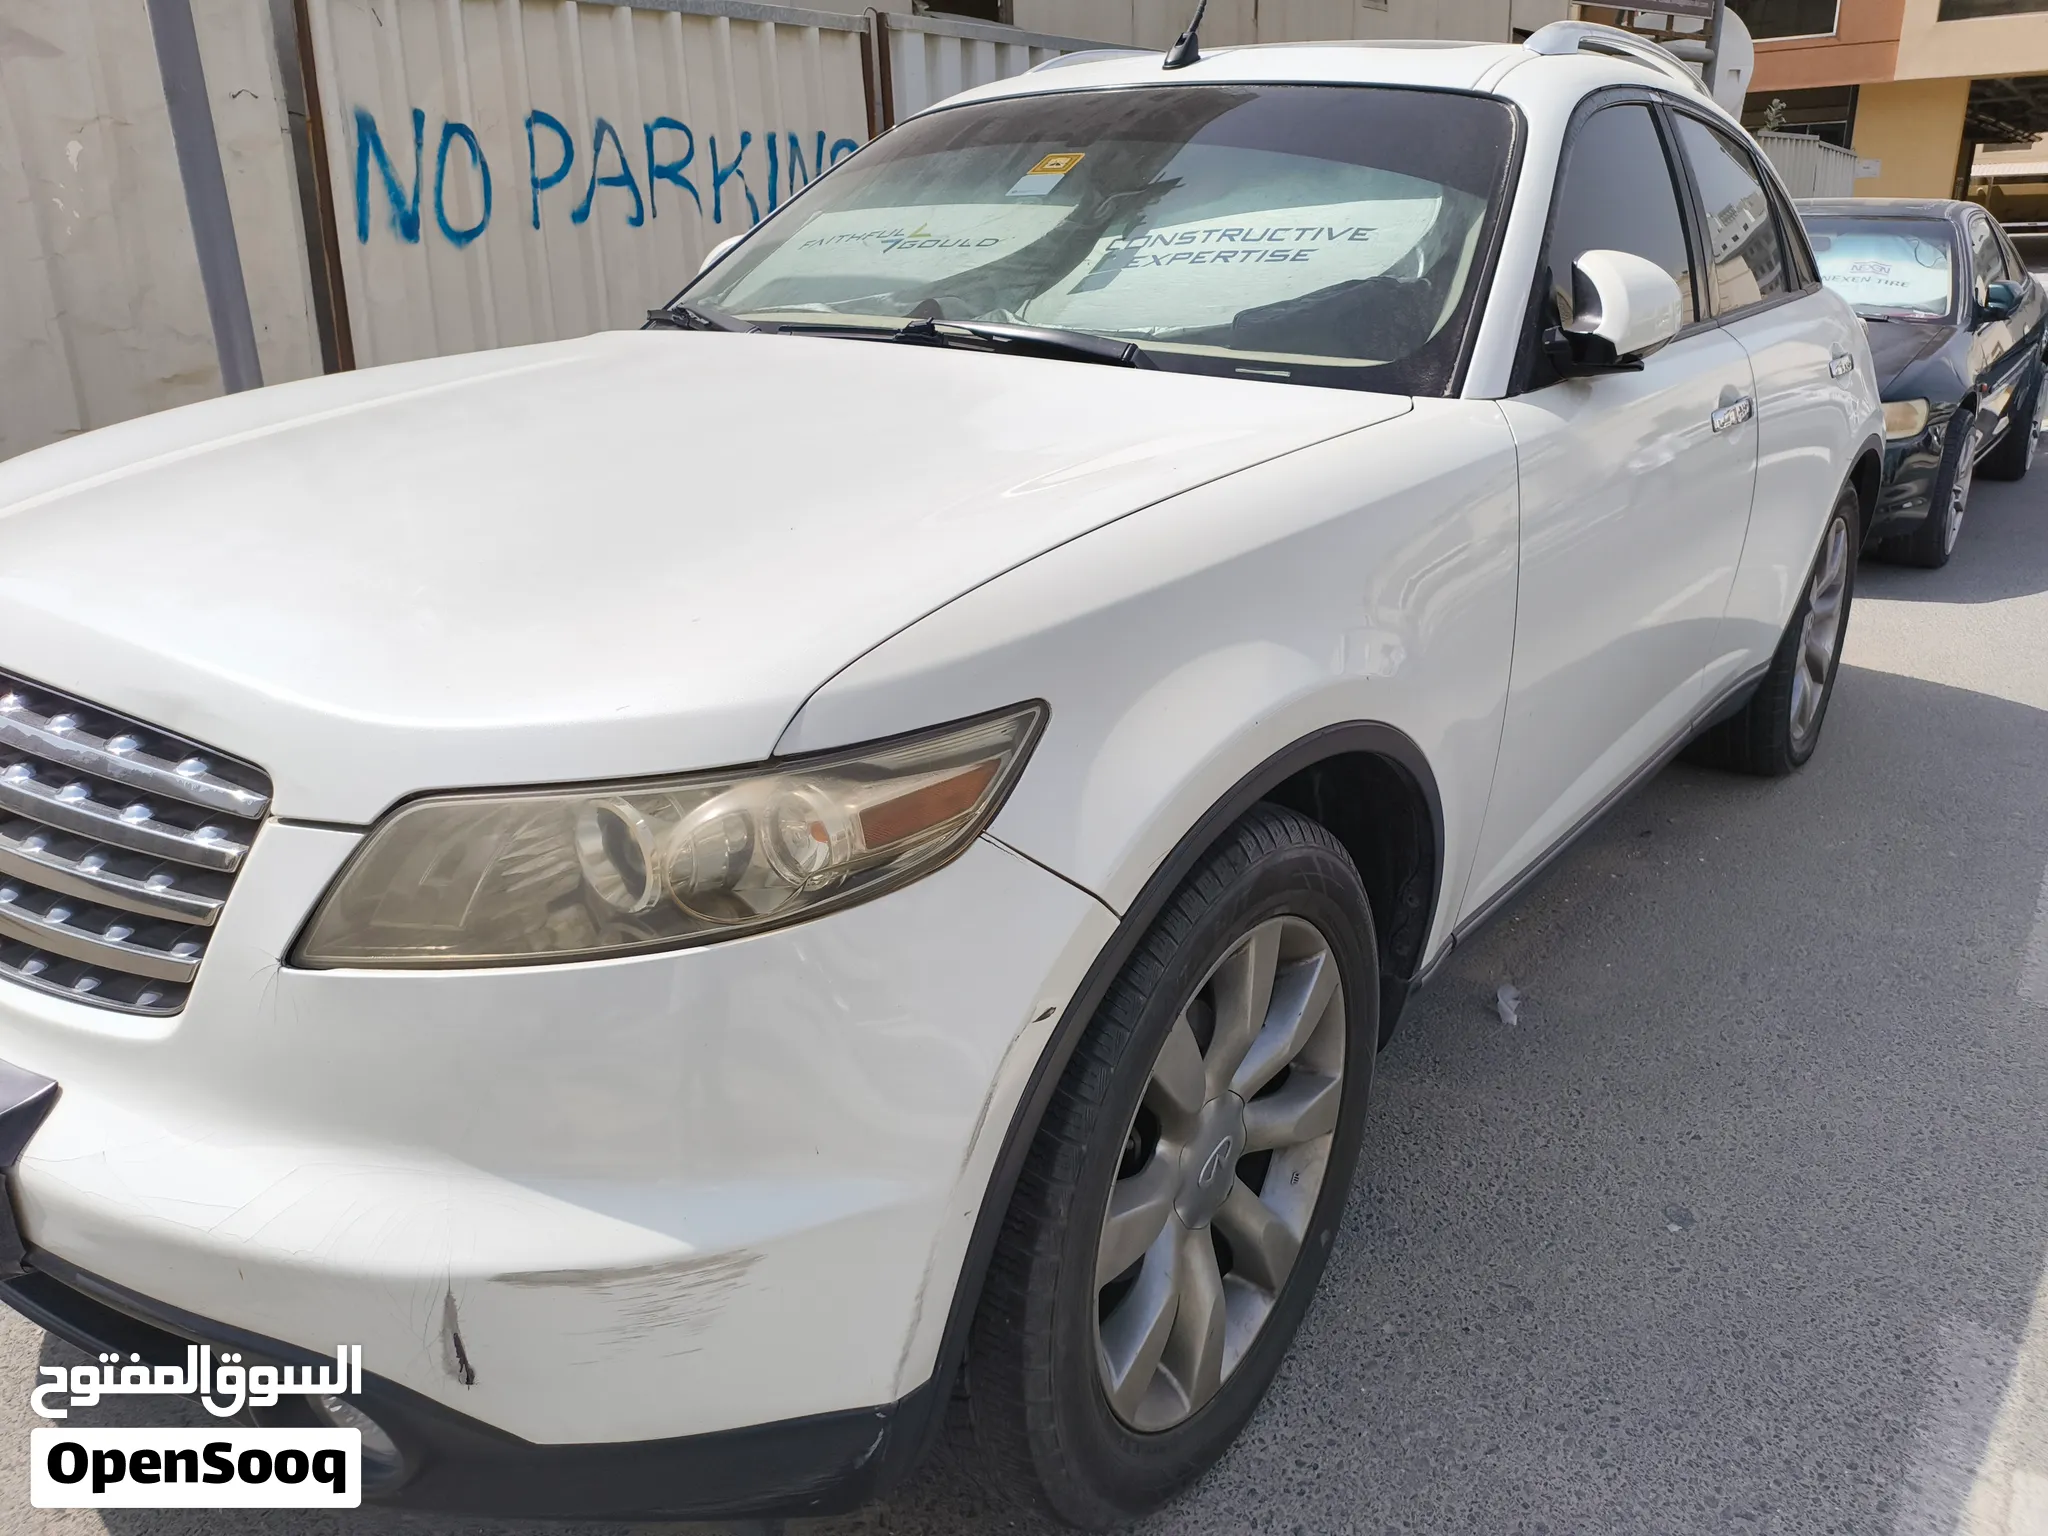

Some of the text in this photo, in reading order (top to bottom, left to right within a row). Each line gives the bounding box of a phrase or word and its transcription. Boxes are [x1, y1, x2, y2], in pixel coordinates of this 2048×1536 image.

[355, 106, 493, 248] NO
[797, 228, 905, 250] FAITHFUL
[897, 237, 1001, 250] GOULD
[1105, 227, 1378, 251] CONSTRUCTIVE
[1124, 248, 1319, 269] EXPERTISE
[1877, 279, 1910, 288] TIRE
